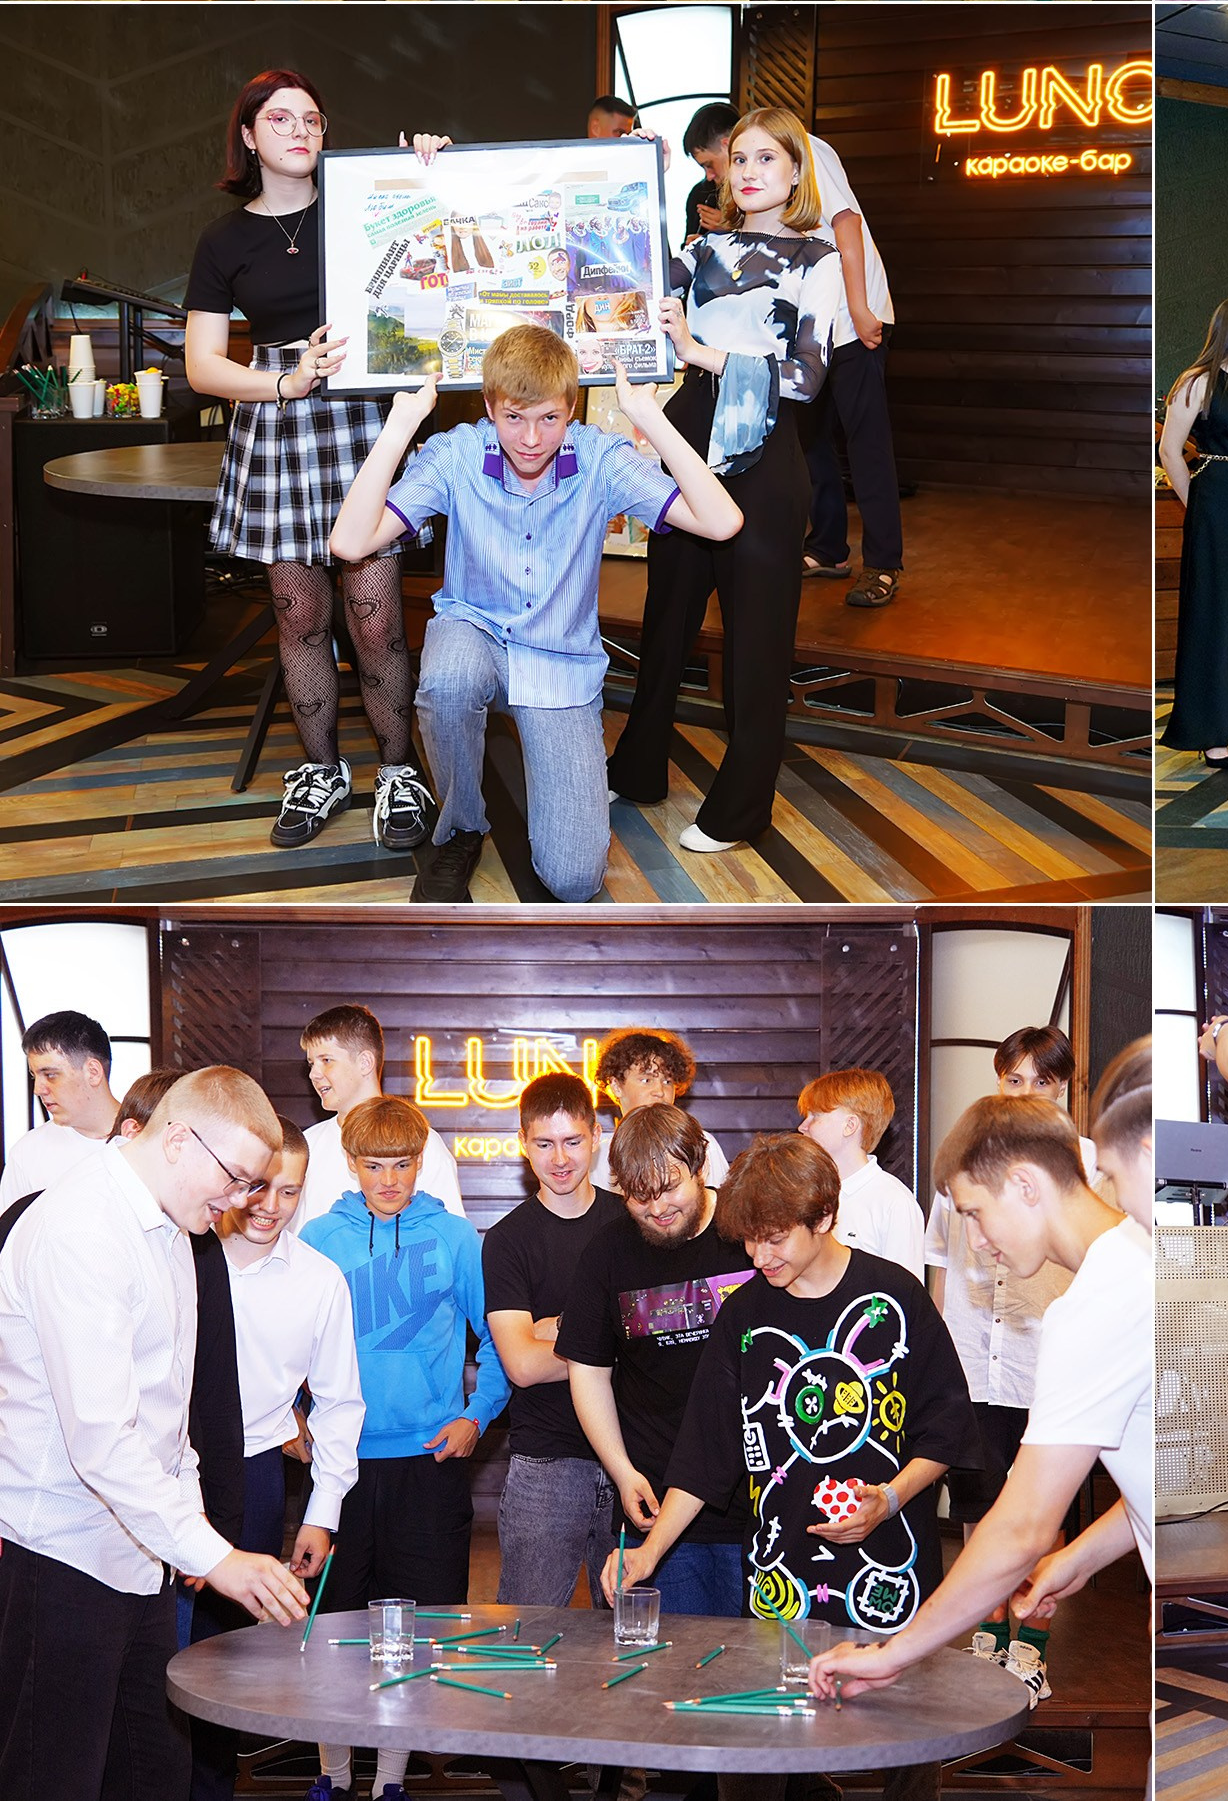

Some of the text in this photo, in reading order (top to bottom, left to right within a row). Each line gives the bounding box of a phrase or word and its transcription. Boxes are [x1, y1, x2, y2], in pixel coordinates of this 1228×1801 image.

[965, 149, 1132, 179] караоке-бар
[365, 240, 400, 295] БРИЛЛИАНТ
[372, 238, 411, 299] ДЛЯ ЦАРИЦЫ
[566, 304, 576, 339] ФОРД
[594, 302, 611, 313] ДИН
[614, 342, 656, 356] «БРАТ-2»
[415, 1036, 600, 1109] LUN
[344, 1238, 437, 1338] IKE
